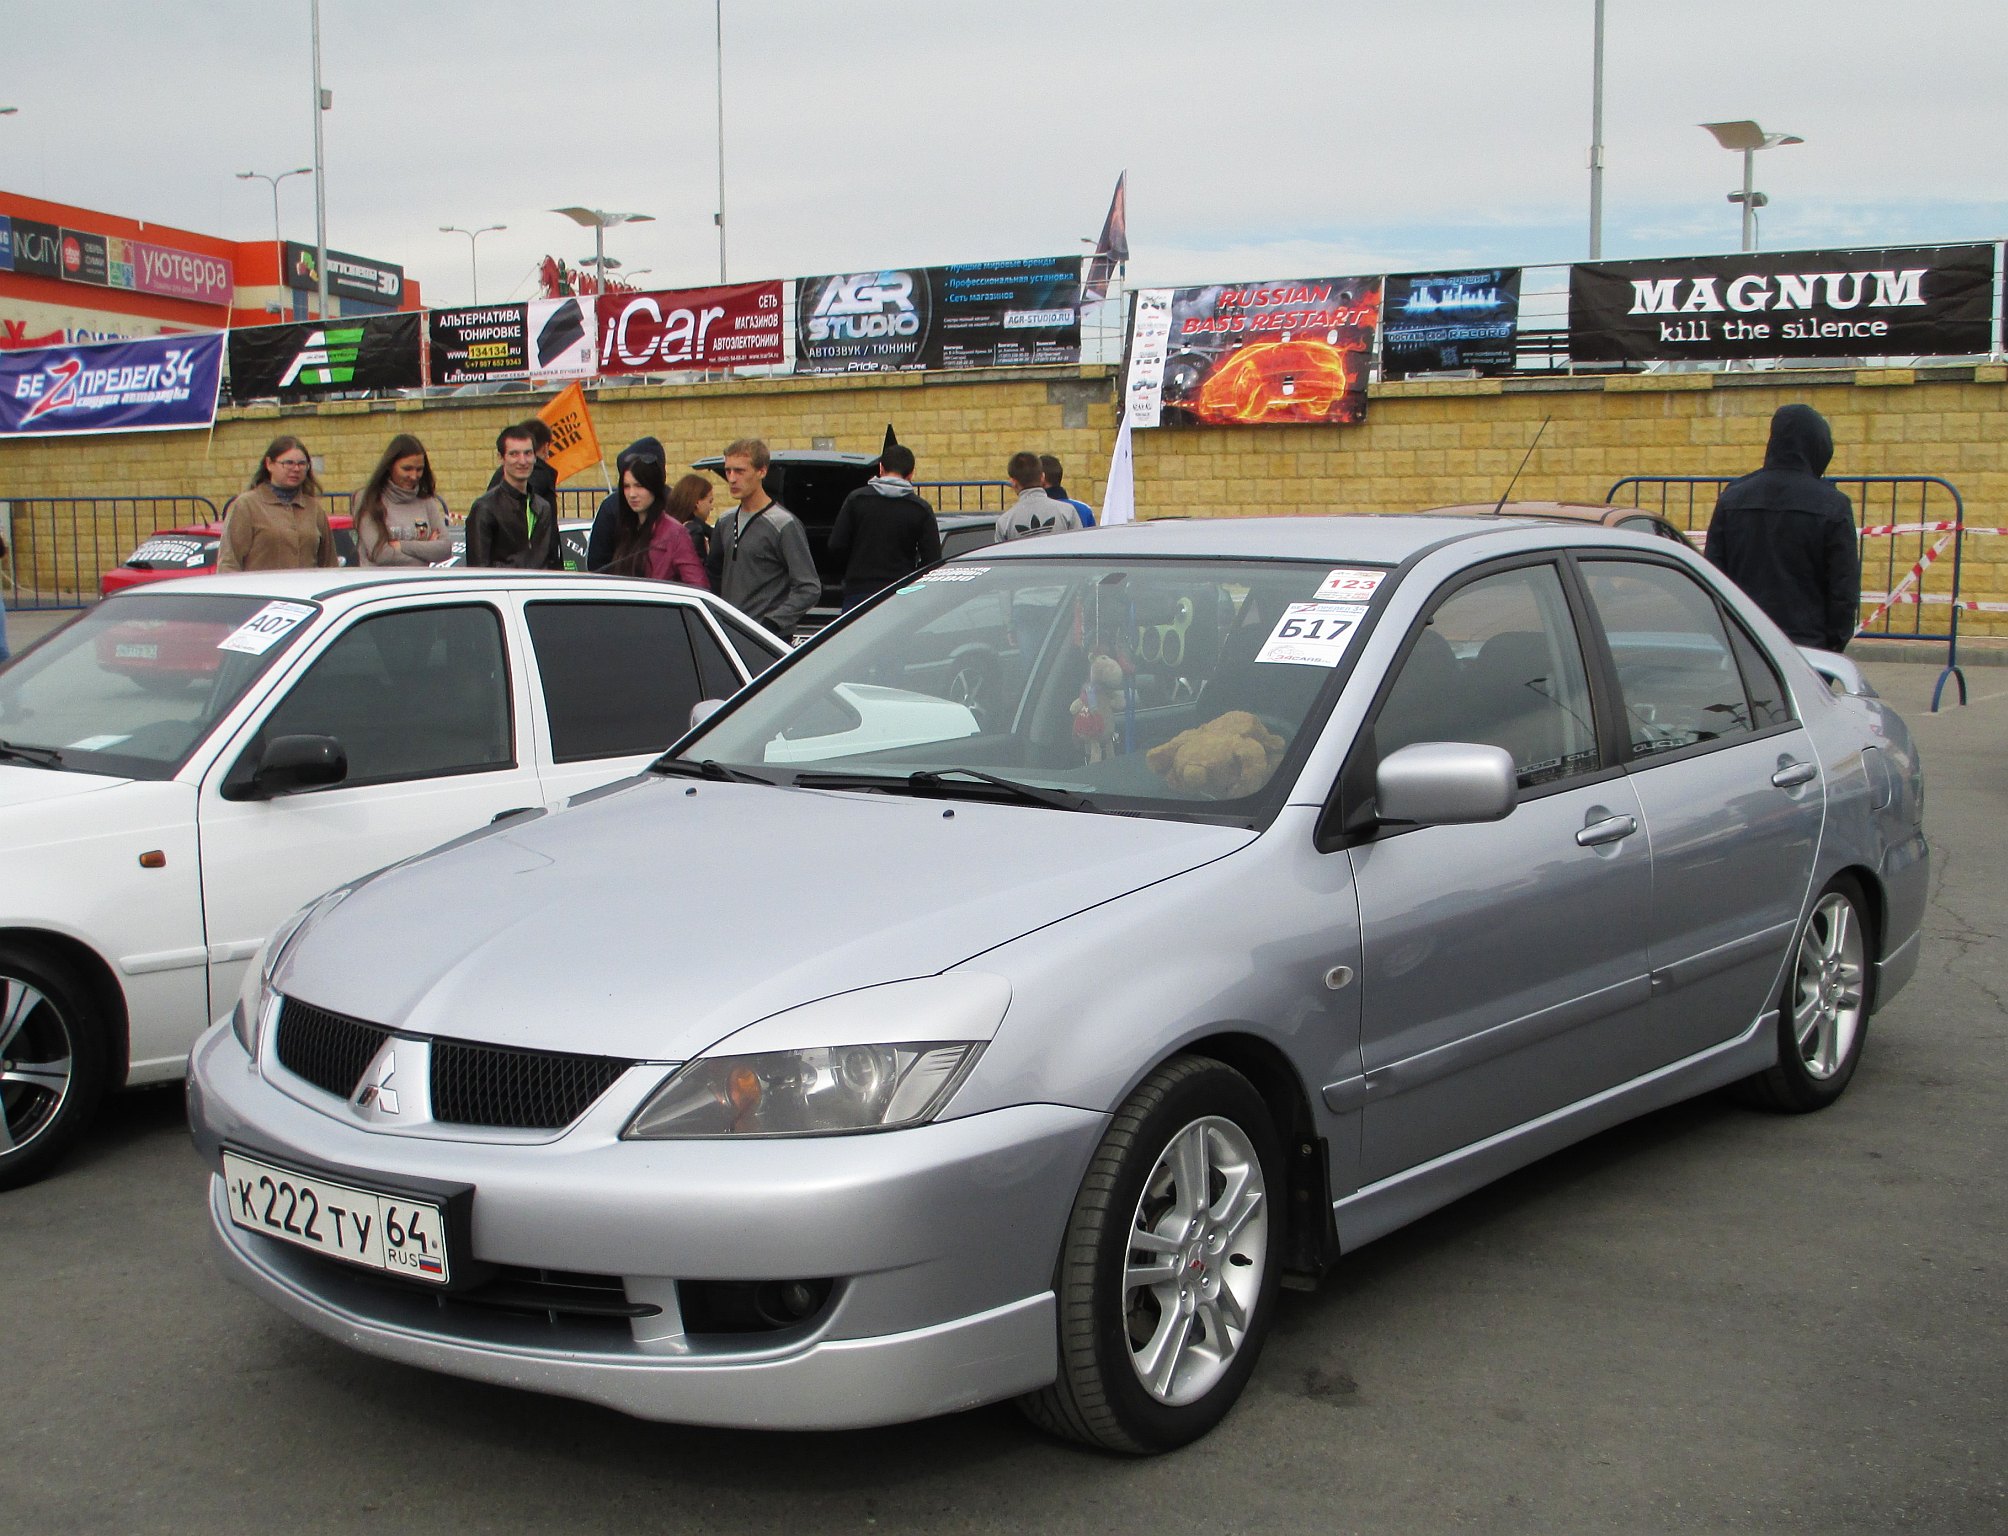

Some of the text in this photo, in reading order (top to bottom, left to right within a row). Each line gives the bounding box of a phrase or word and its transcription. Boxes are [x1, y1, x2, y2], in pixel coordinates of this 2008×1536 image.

[949, 275, 1028, 289] Профессиональная
[758, 294, 778, 308] СЕТЬ
[949, 293, 968, 303] Сеть
[1218, 284, 1332, 309] RUSSIAN
[1627, 268, 1928, 316] MAGNUM
[439, 309, 521, 328] АЛЬТЕРНАТИВА
[734, 314, 778, 330] МАГАЗИНОВ
[808, 311, 920, 341] STUDIO
[1008, 313, 1071, 325] AGR-STUDIO.RU
[1180, 308, 1369, 335] BASS RESTART
[459, 325, 521, 342] ТОНИРОВКЕ
[601, 297, 725, 366] iCar
[1659, 317, 1888, 342] kill the silence
[712, 333, 778, 351] АВТОЭЛЕКТРОНИКИ
[808, 345, 861, 358] АВТОЗВУК
[872, 341, 918, 354] ТЮНИНГ
[160, 348, 195, 388] 34
[847, 361, 879, 372] Pride
[1329, 579, 1376, 590] 123
[1278, 618, 1353, 640] Б17
[386, 1206, 428, 1253] 64
[388, 1247, 419, 1268] RUS
